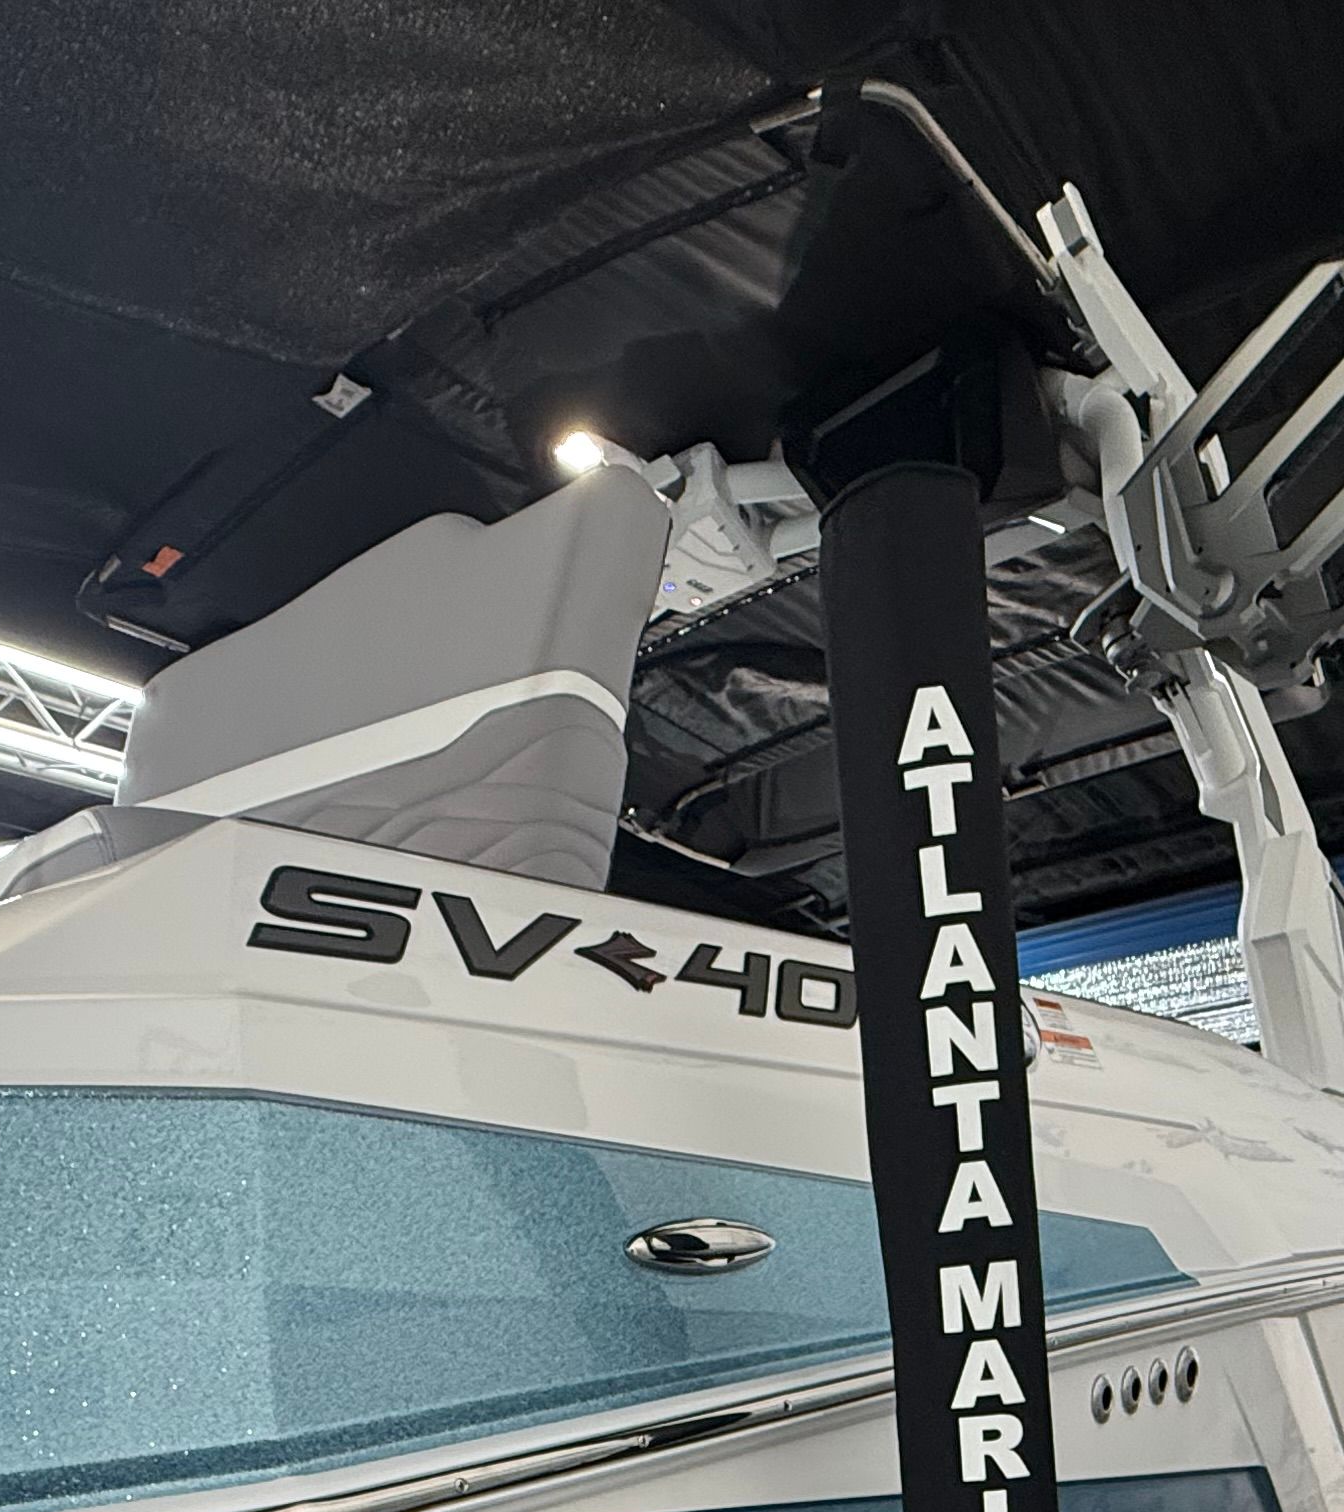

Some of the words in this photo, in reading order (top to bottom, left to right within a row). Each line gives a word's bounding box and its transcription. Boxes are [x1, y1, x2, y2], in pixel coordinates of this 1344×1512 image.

[246, 864, 583, 982] SV
[674, 943, 859, 1030] 40
[897, 684, 1014, 1234] ATLANTA
